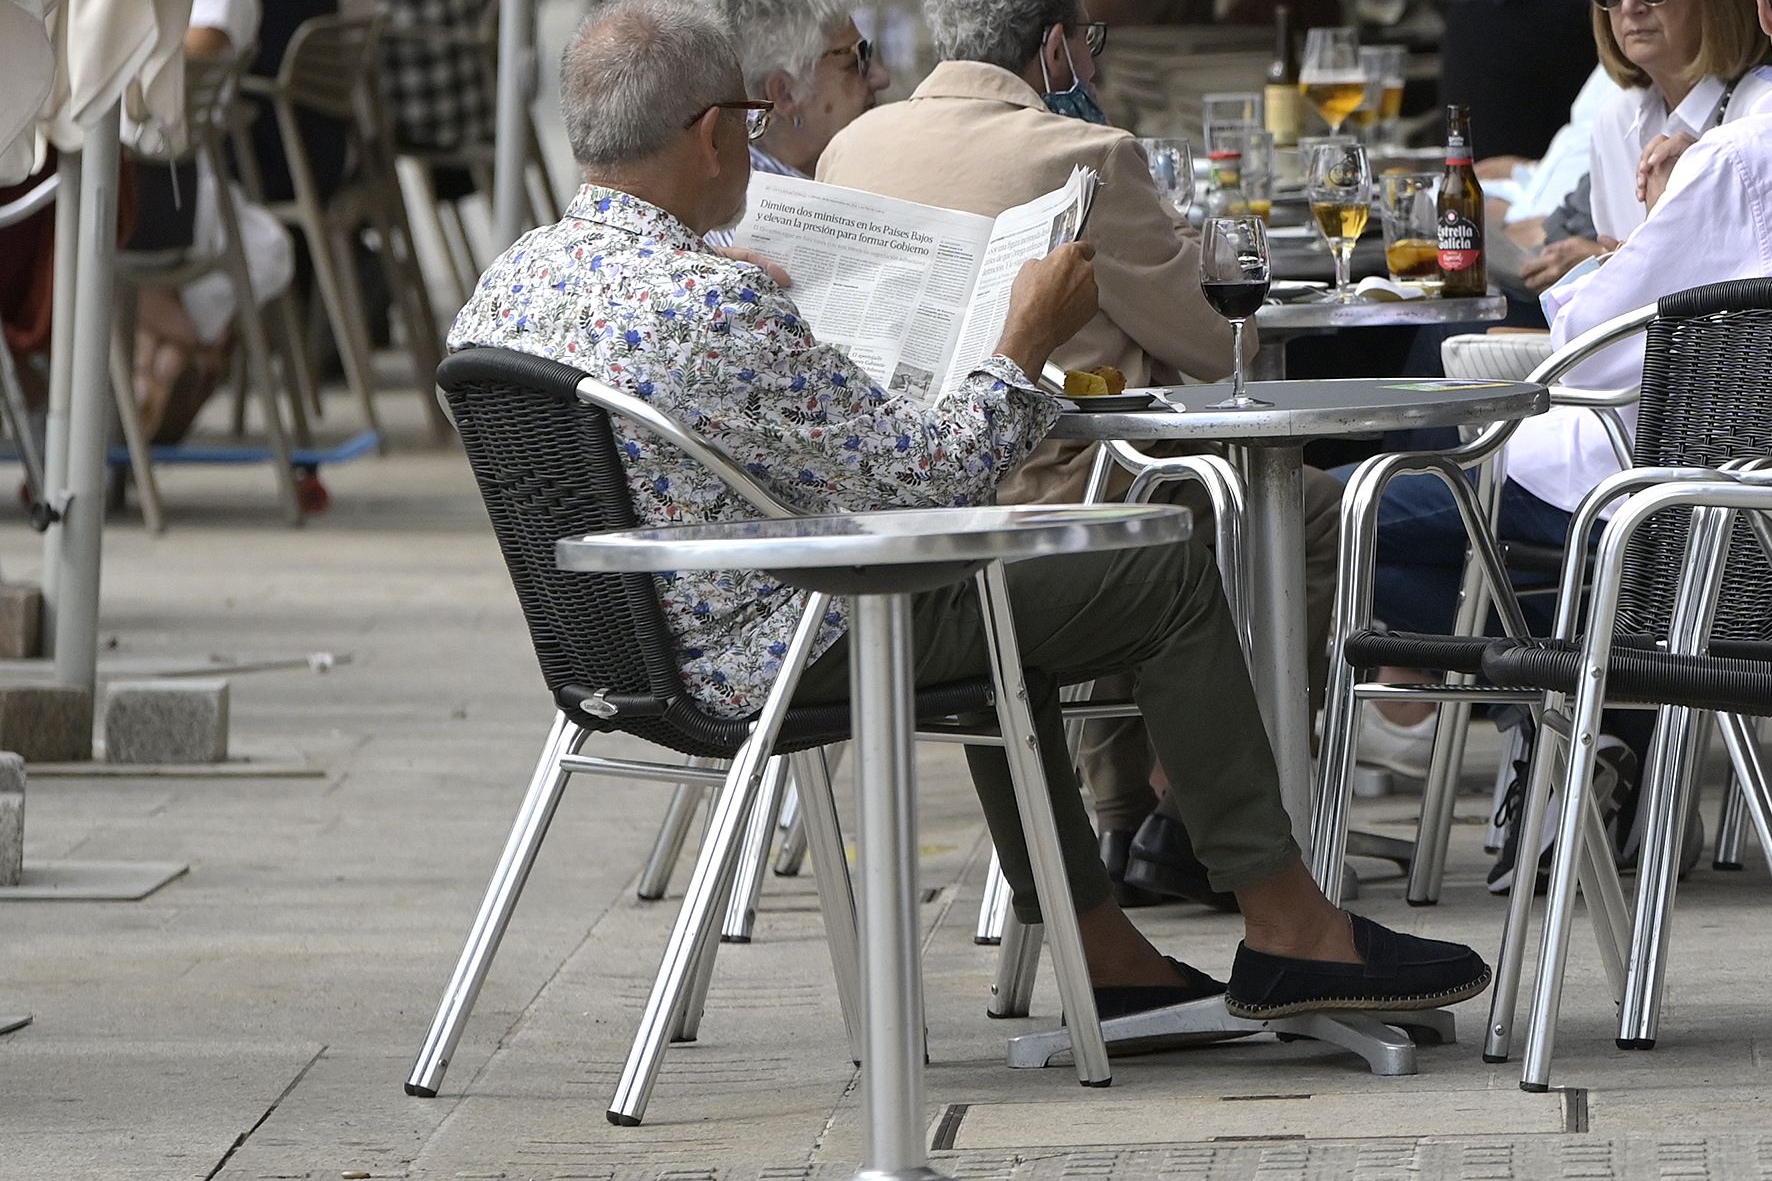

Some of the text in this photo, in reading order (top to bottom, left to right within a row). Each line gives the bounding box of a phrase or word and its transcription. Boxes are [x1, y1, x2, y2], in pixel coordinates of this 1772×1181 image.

[755, 212, 763, 221] y
[763, 212, 792, 226] elevan
[794, 218, 802, 228] la
[802, 223, 836, 236] presión
[836, 230, 857, 241] para
[858, 232, 889, 247] formar
[889, 239, 929, 256] Gobierno
[760, 199, 795, 214] Dimiten
[796, 206, 813, 217] dos
[813, 211, 855, 227] ministras
[856, 221, 867, 230] en
[869, 221, 881, 232] los
[883, 225, 909, 239] Países
[910, 231, 934, 244] Bajos
